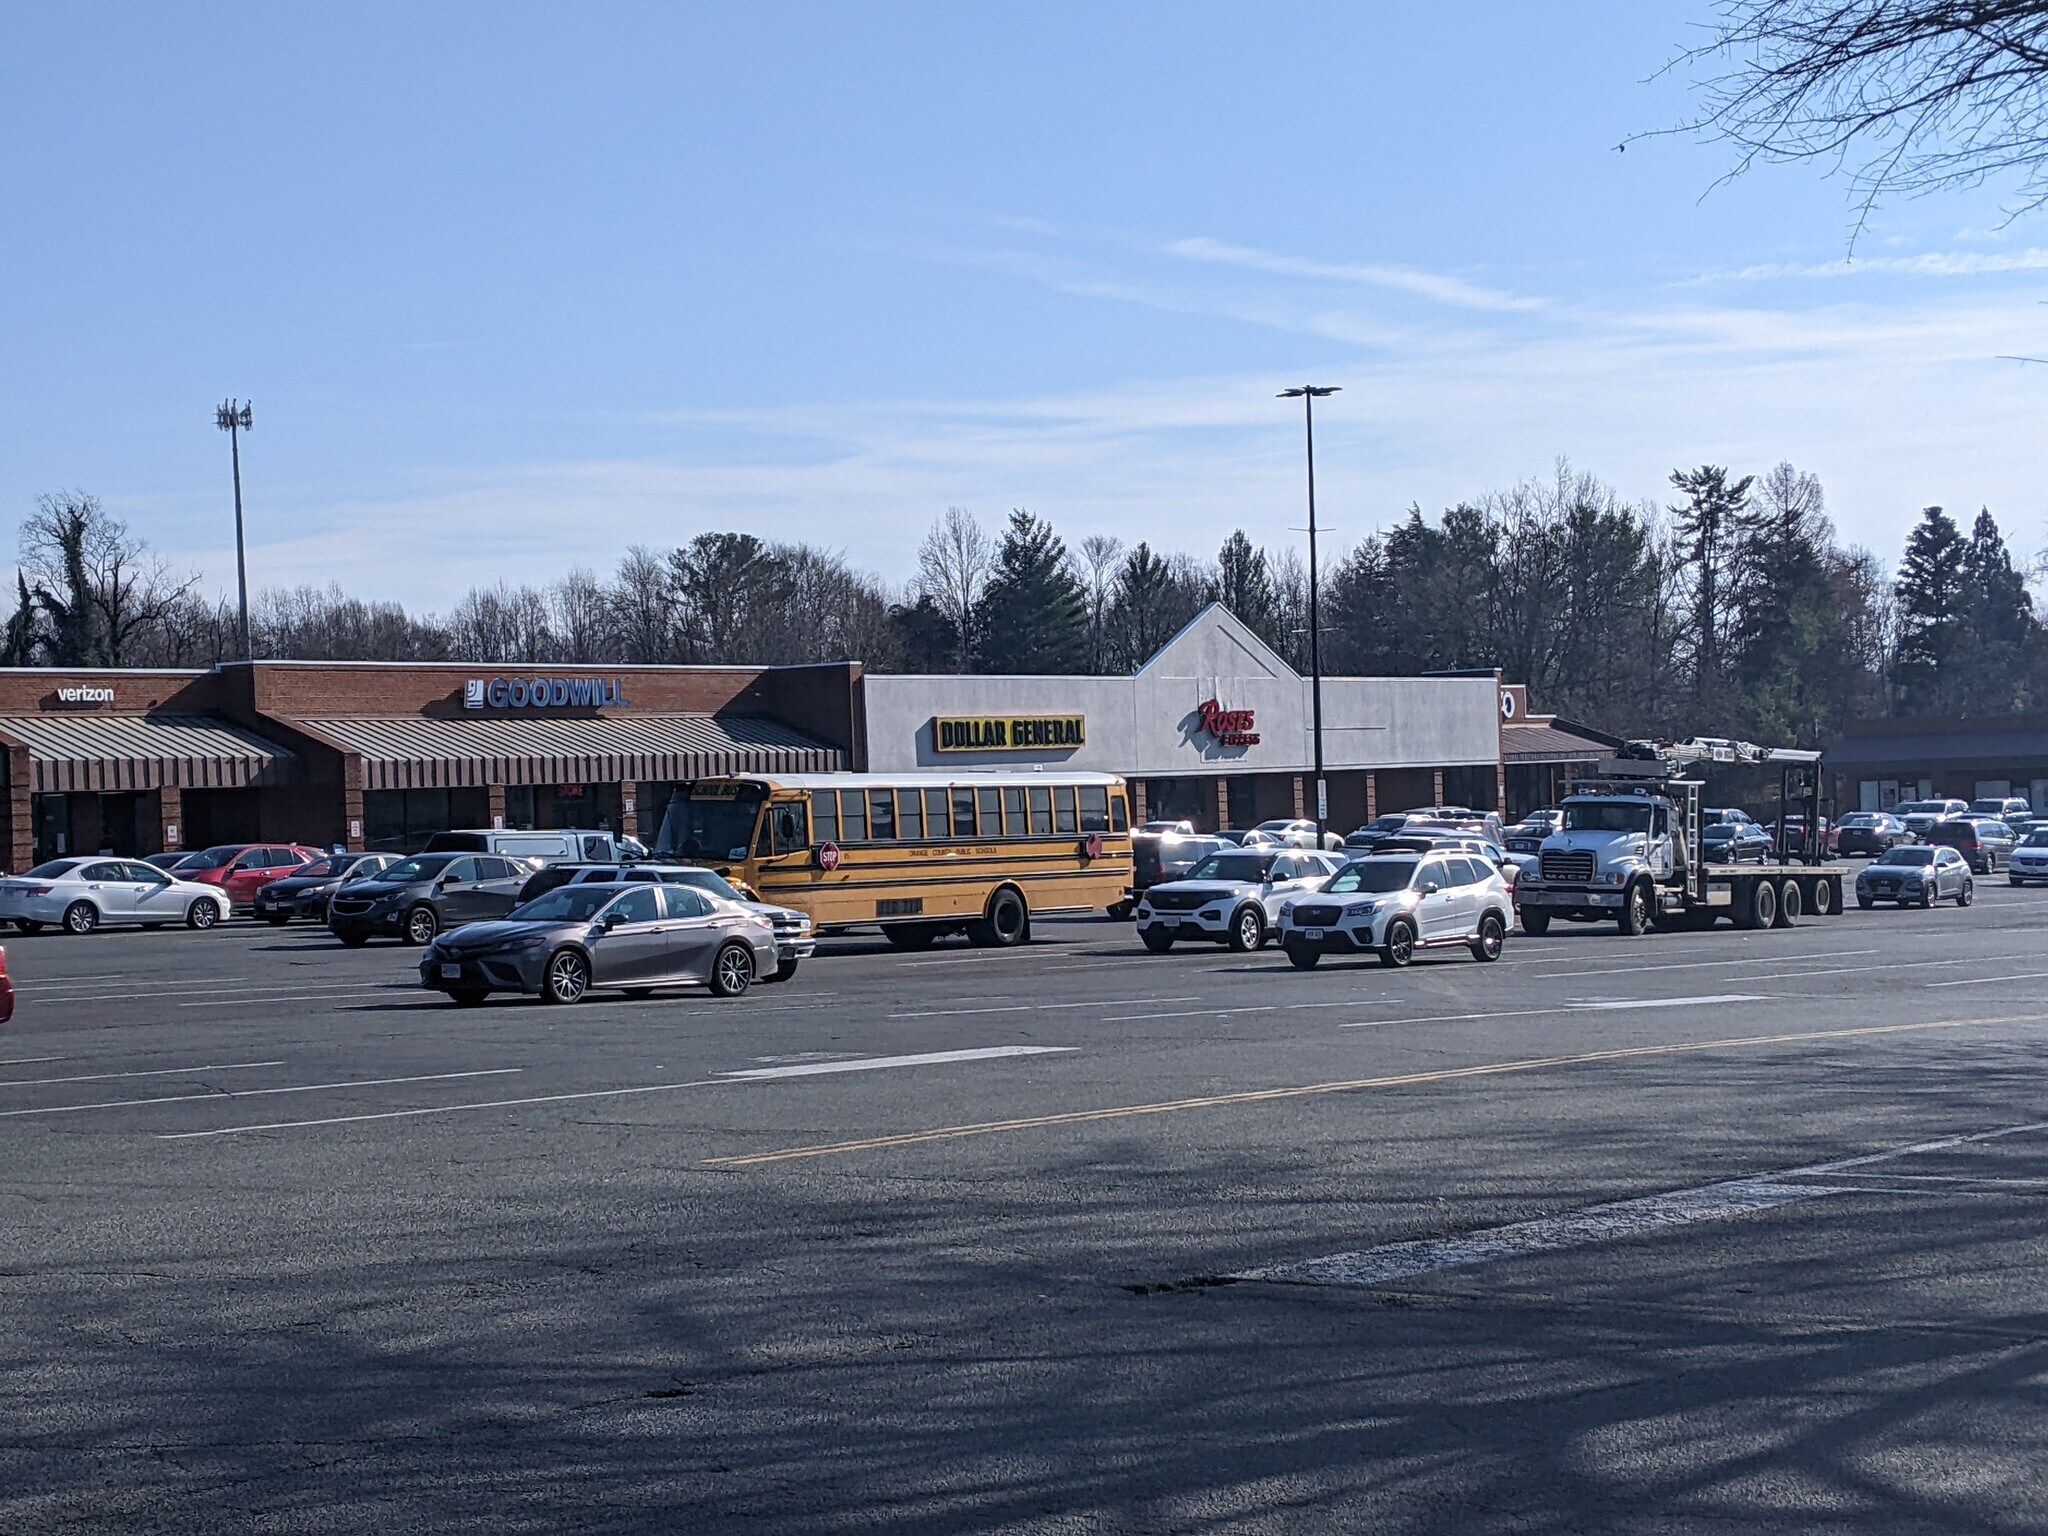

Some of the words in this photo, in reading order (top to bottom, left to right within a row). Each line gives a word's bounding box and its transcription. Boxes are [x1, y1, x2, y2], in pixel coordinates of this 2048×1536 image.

[57, 684, 114, 701] verizon
[487, 677, 630, 708] GOODWILL
[941, 721, 1007, 748] DOLLAR
[1011, 719, 1084, 745] GENERAL
[822, 851, 837, 862] STOP
